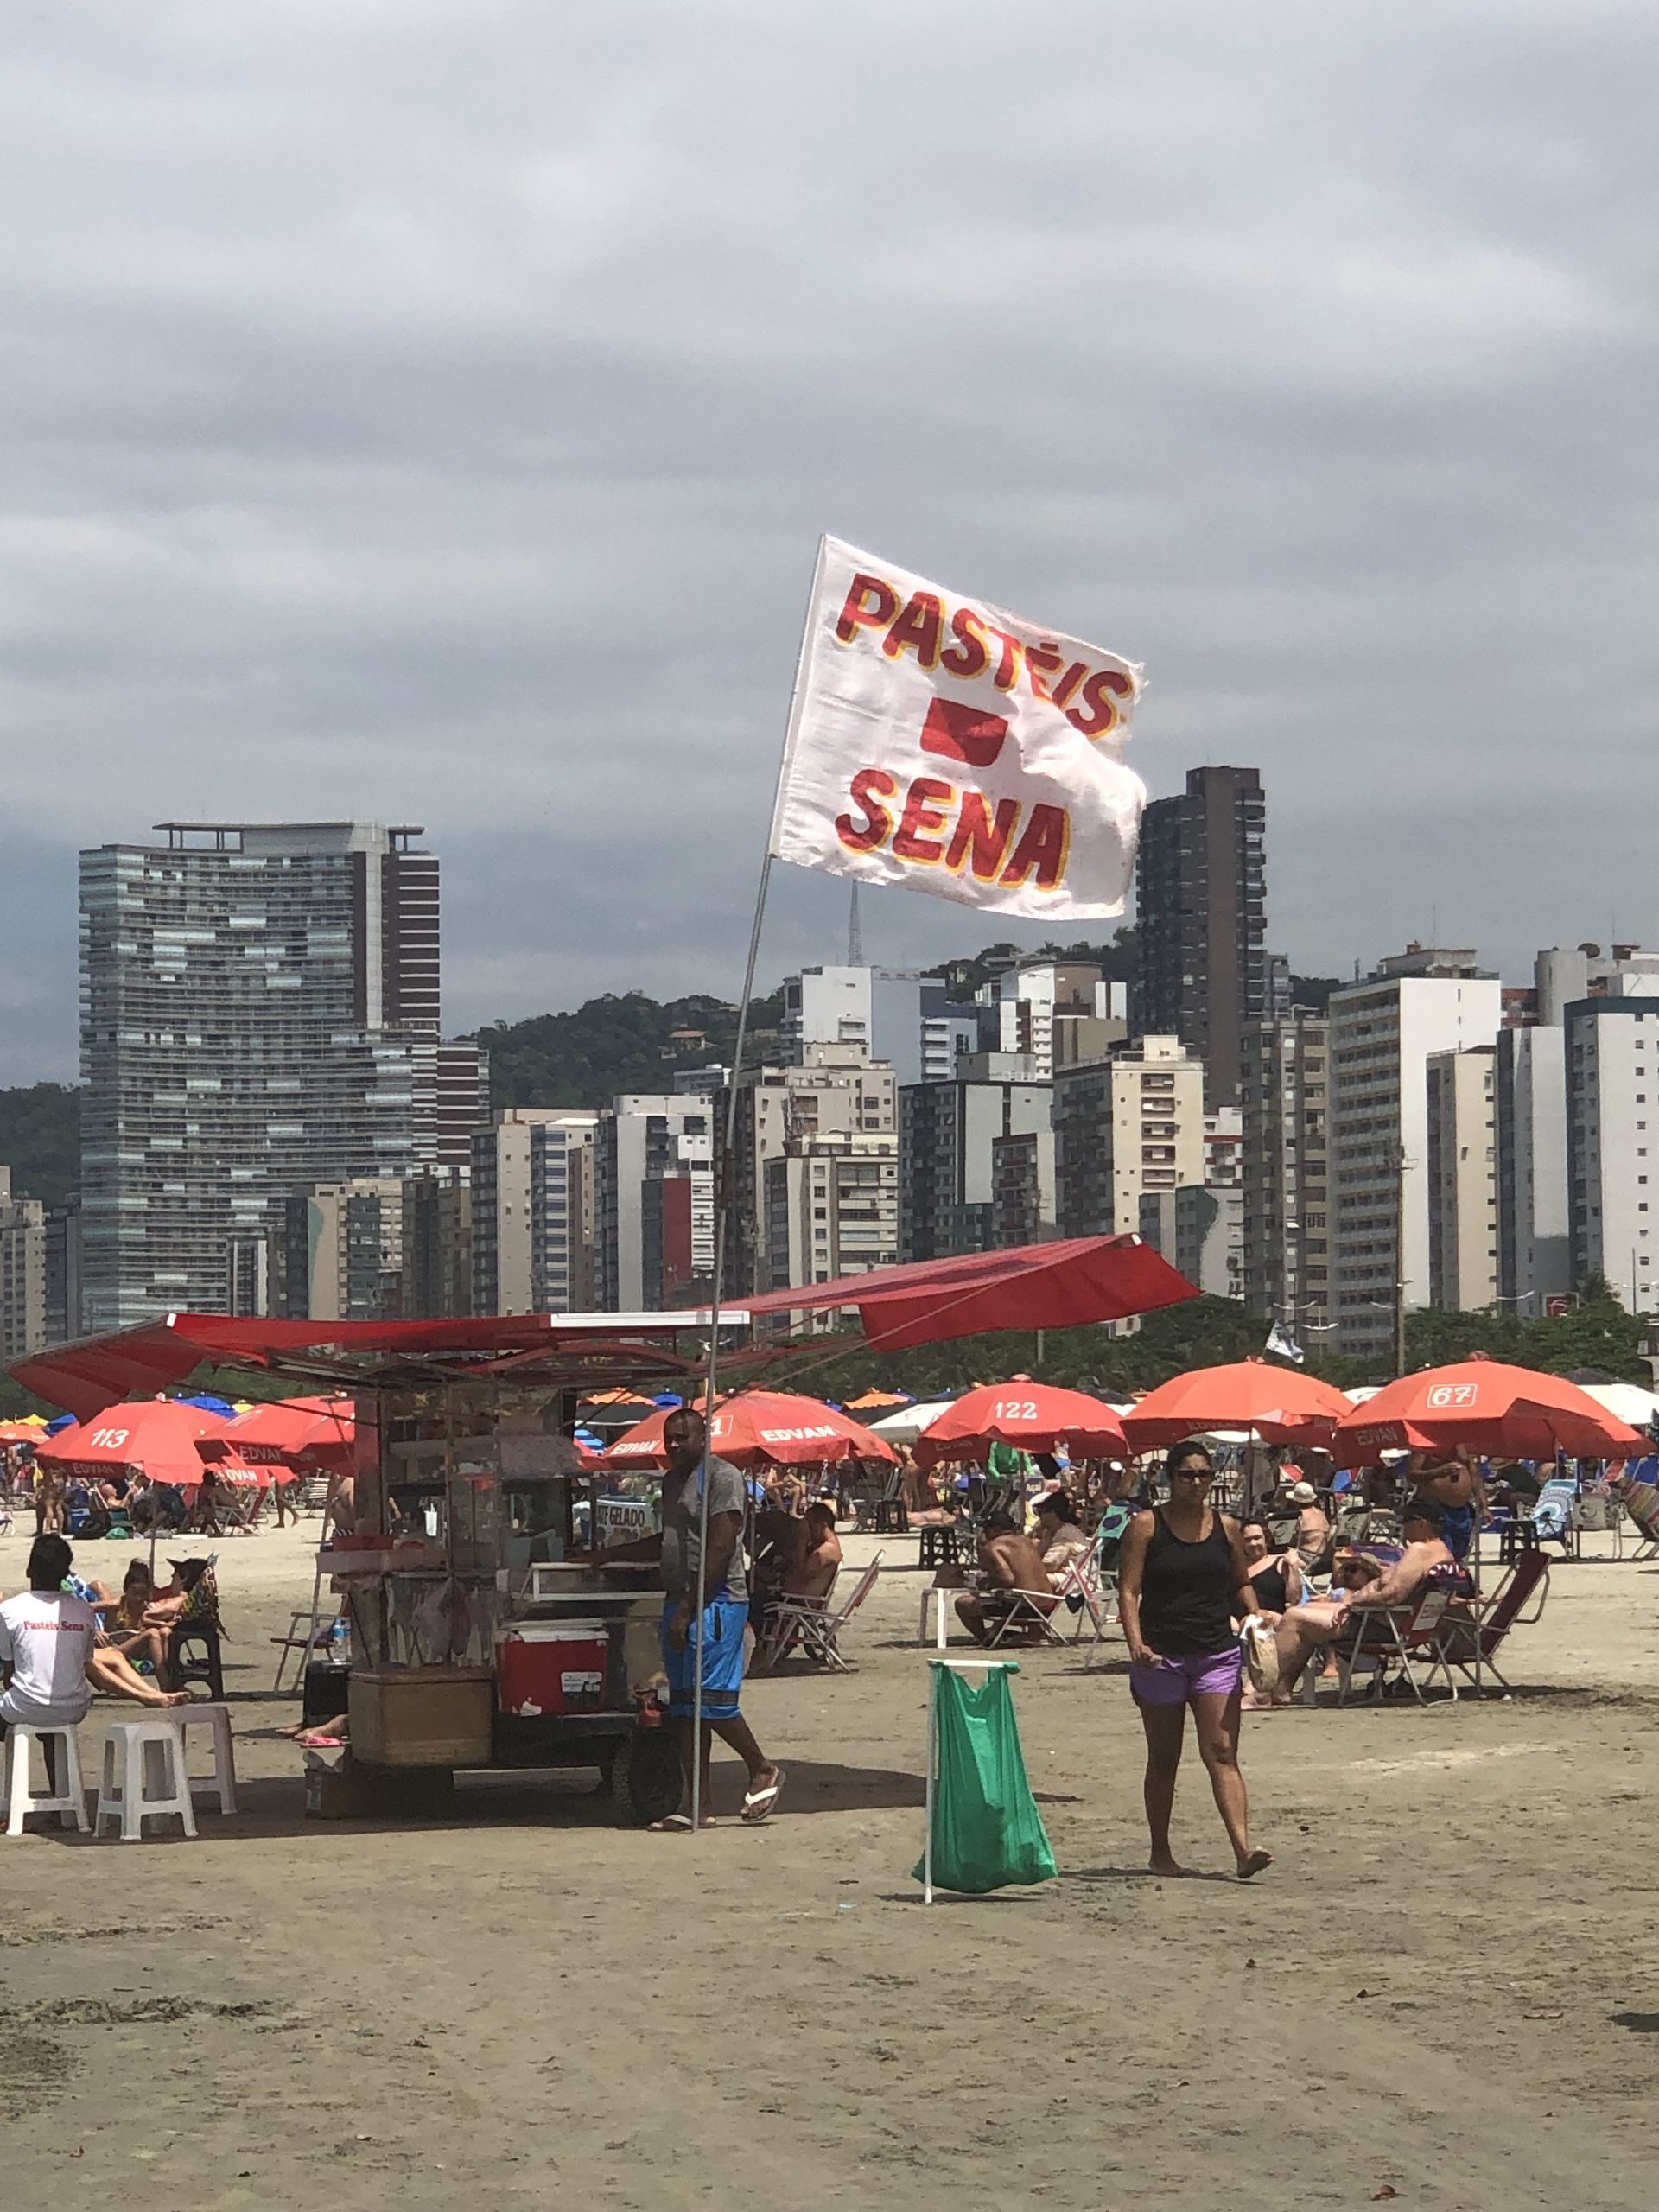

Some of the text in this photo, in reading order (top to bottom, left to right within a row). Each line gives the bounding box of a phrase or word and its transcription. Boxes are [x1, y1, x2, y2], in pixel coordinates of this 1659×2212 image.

[835, 768, 1071, 892] SENA
[1432, 1386, 1471, 1405] 67
[994, 1401, 1038, 1420] 122
[90, 1427, 130, 1449] 113
[760, 1424, 838, 1443] EDVAN
[1355, 1426, 1399, 1446] EDVAN
[610, 1440, 660, 1455] EDVAN
[60, 1620, 85, 1632] Sena
